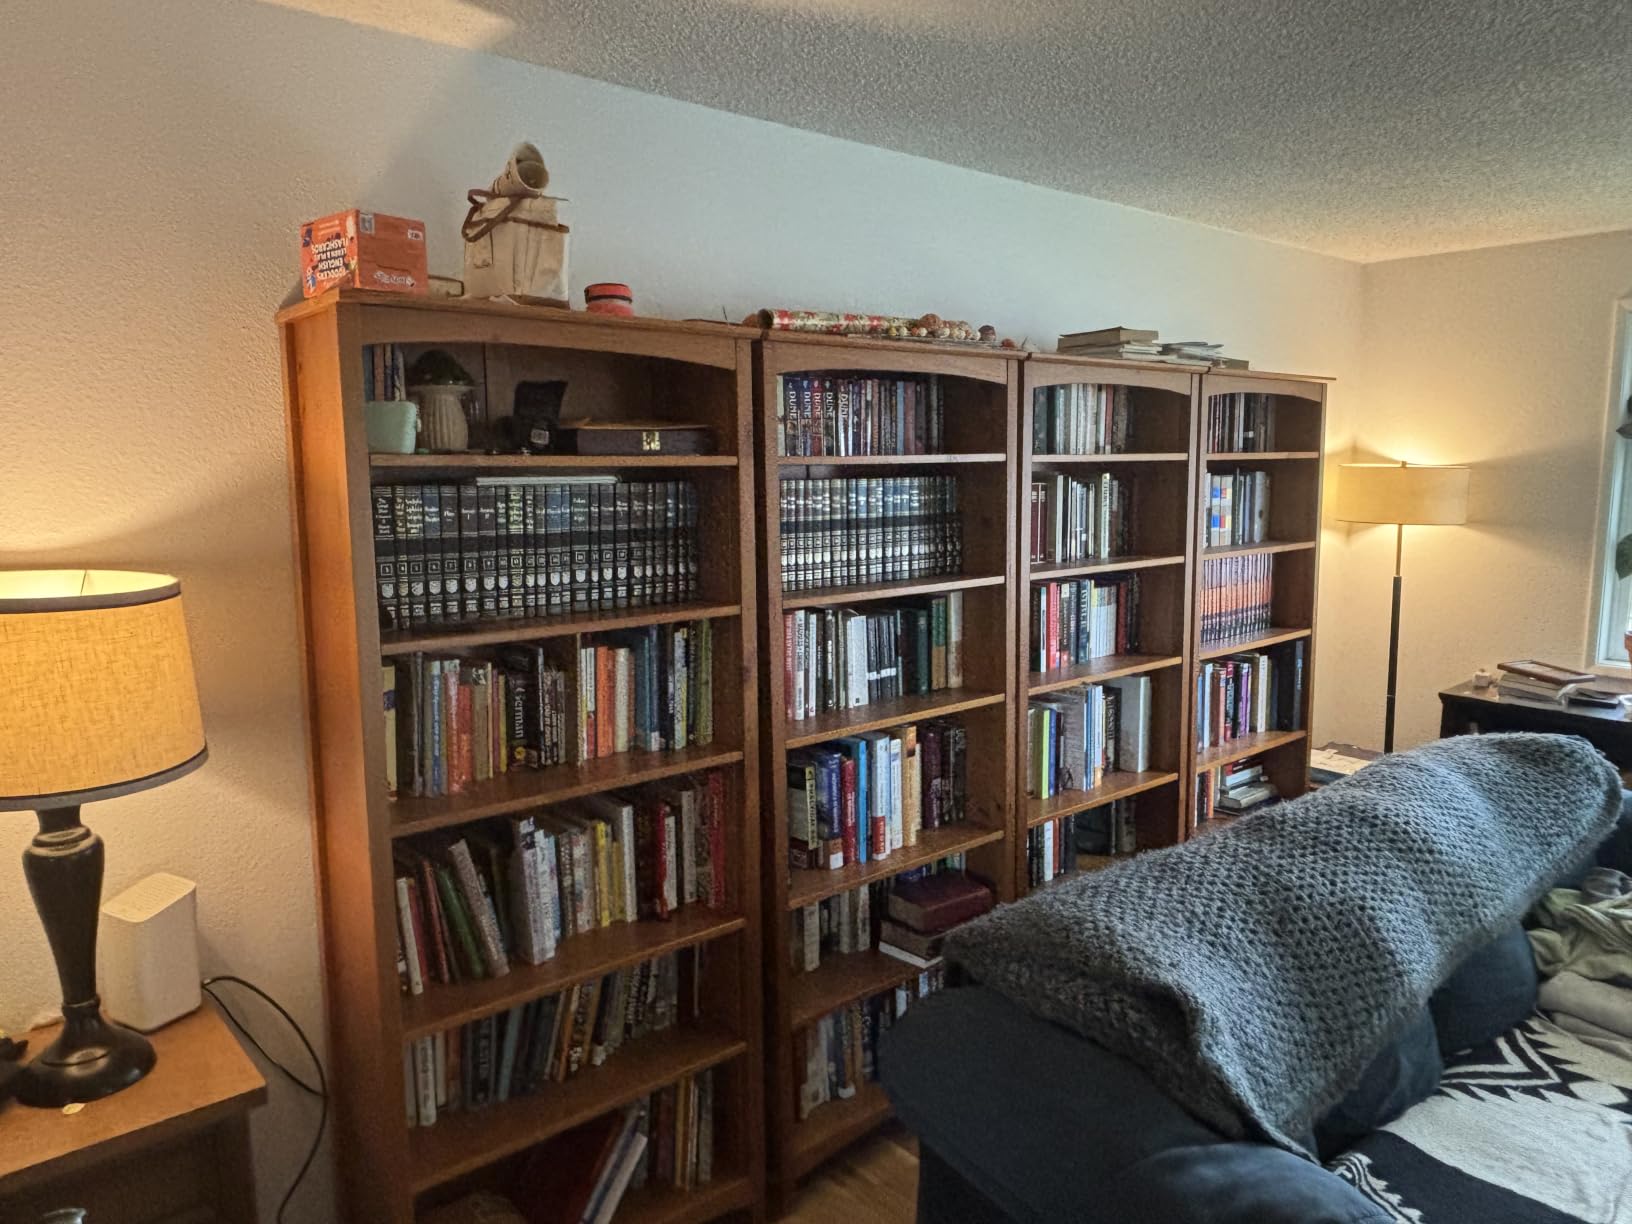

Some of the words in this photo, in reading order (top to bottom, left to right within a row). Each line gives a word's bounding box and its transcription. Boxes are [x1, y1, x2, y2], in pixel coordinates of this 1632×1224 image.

[318, 257, 344, 270] ENGLISH
[789, 391, 797, 420] DUNE
[514, 687, 526, 738] German
